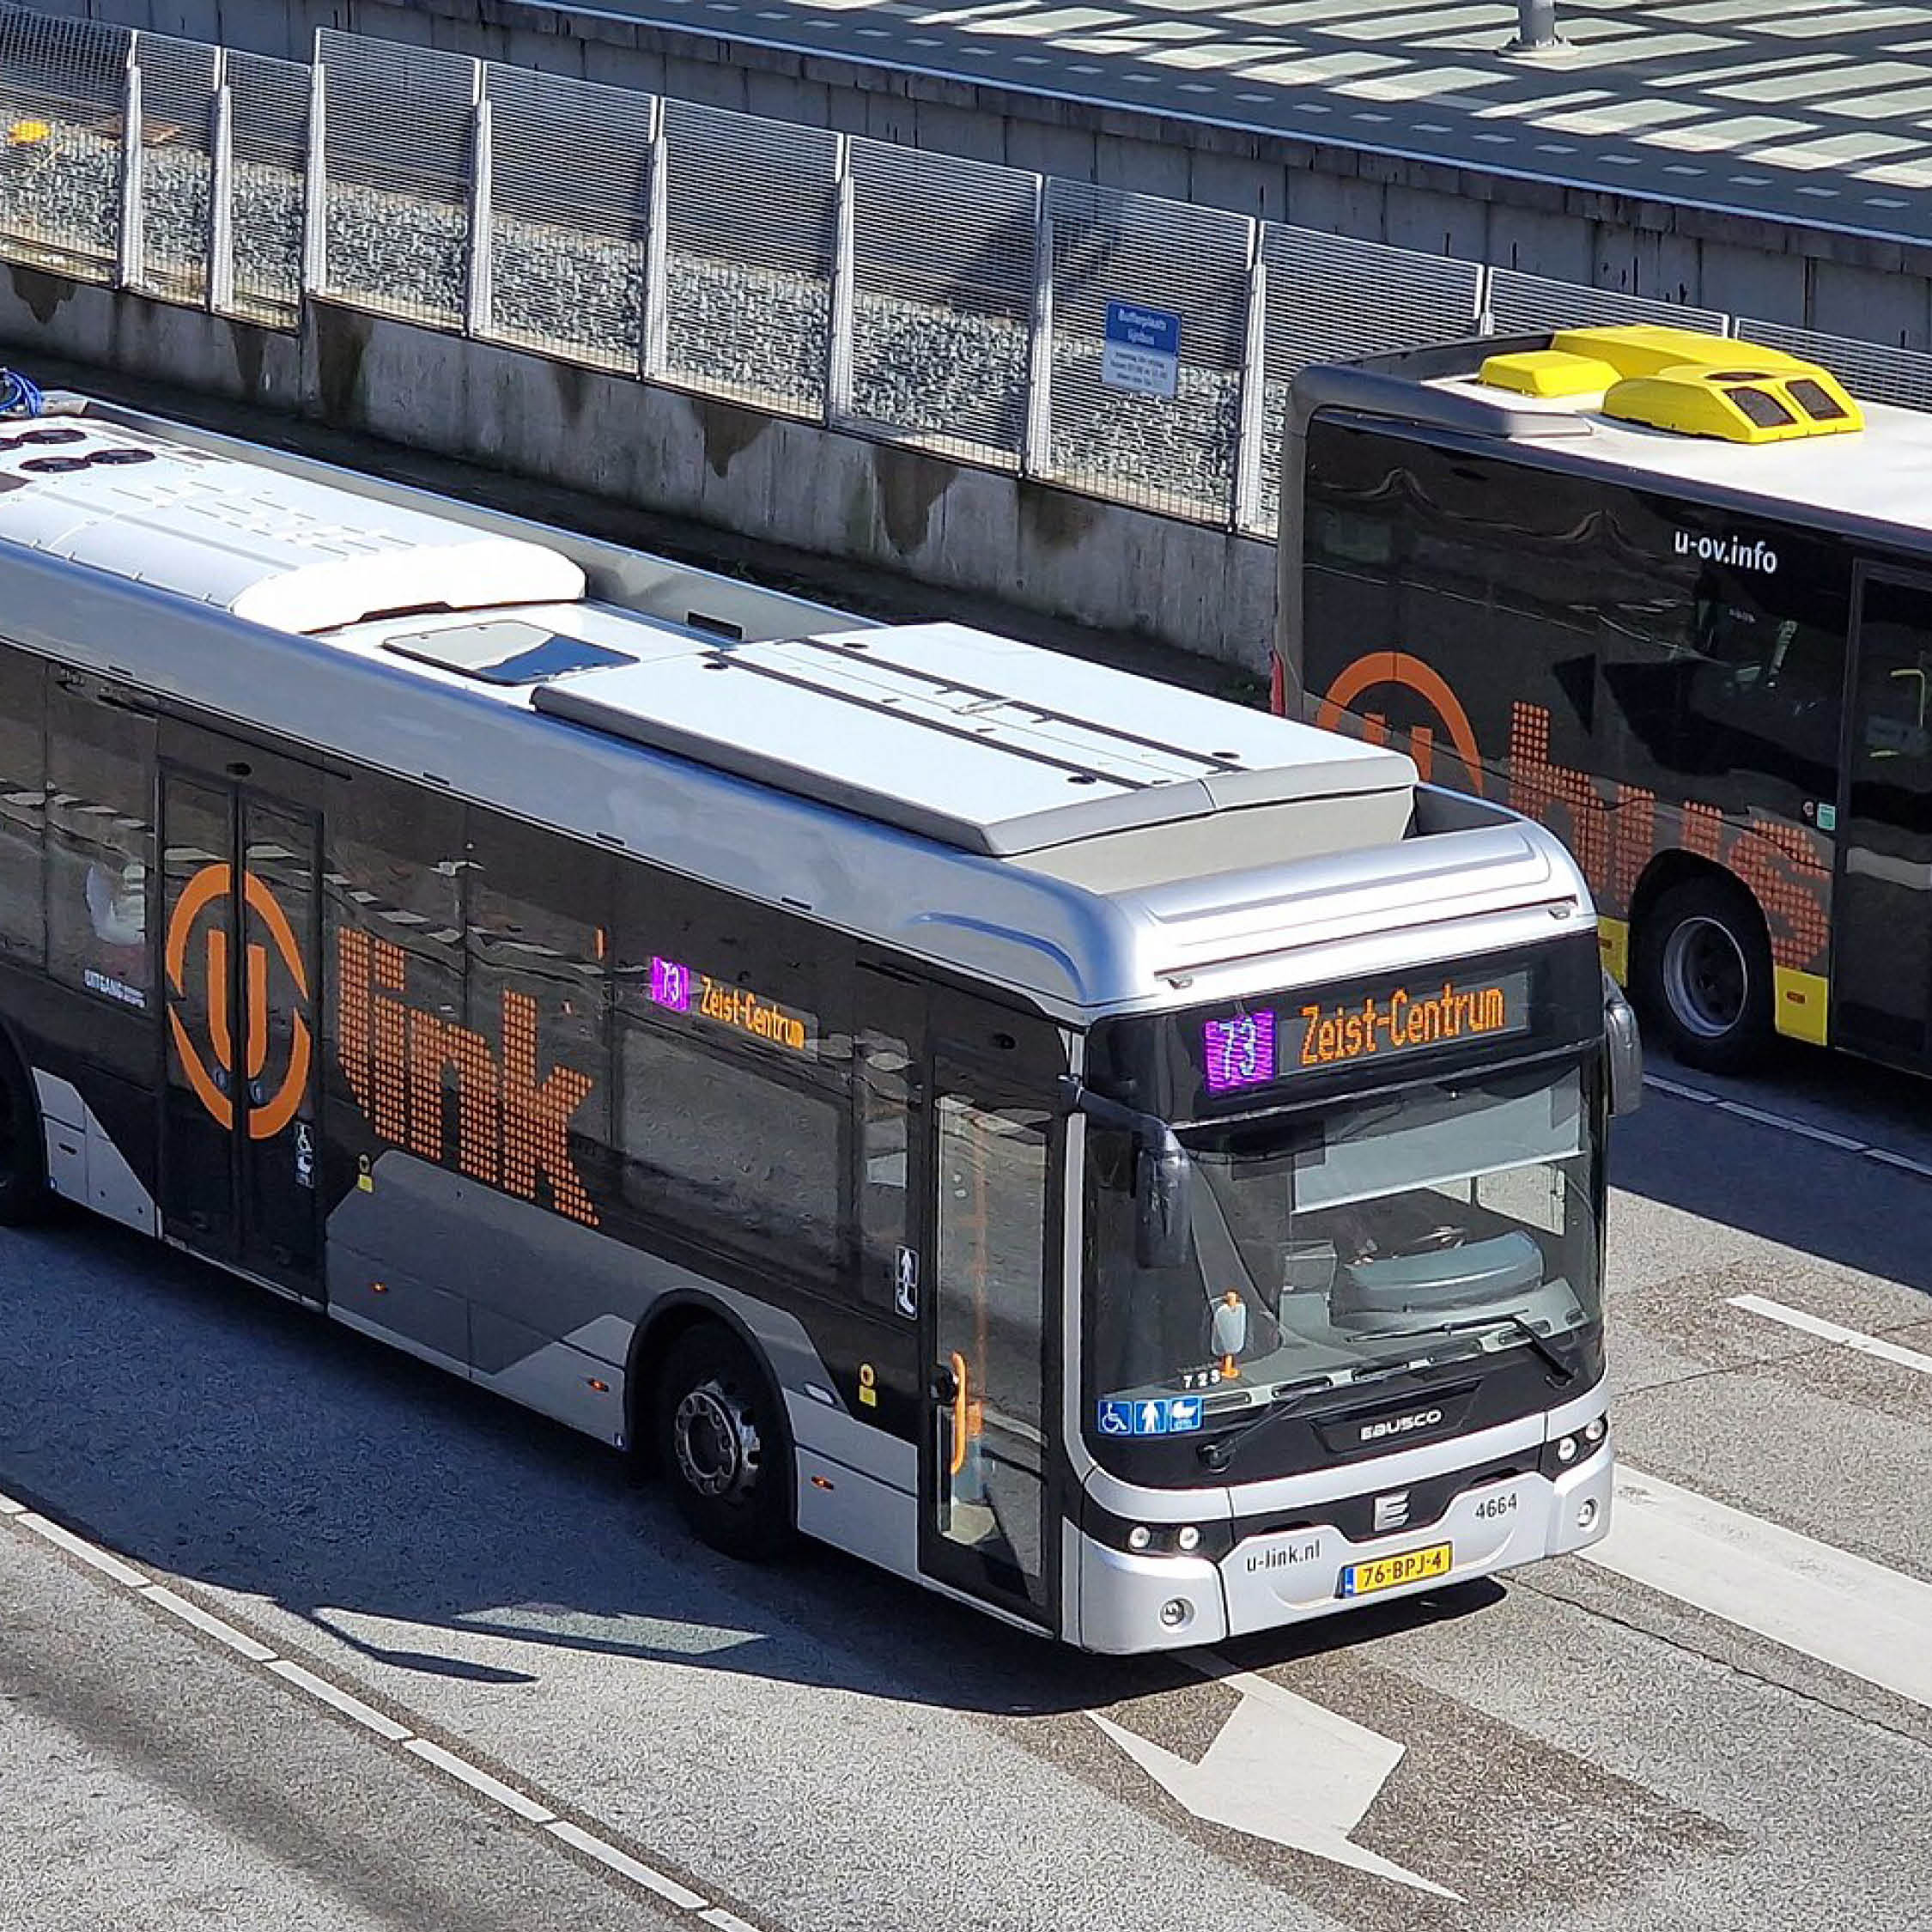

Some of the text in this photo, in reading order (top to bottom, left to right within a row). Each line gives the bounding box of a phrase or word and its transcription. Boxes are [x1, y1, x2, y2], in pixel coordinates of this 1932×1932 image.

[1674, 531, 1777, 574] u-ov.info
[1218, 981, 1505, 1080] 73 Zeist-Centrum
[337, 926, 599, 1226] link
[1360, 1409, 1442, 1441] EBUSCO
[1474, 1492, 1518, 1520] 4664
[1247, 1539, 1321, 1572] u-link.nl
[1363, 1551, 1442, 1588] 76-BPJ-4
